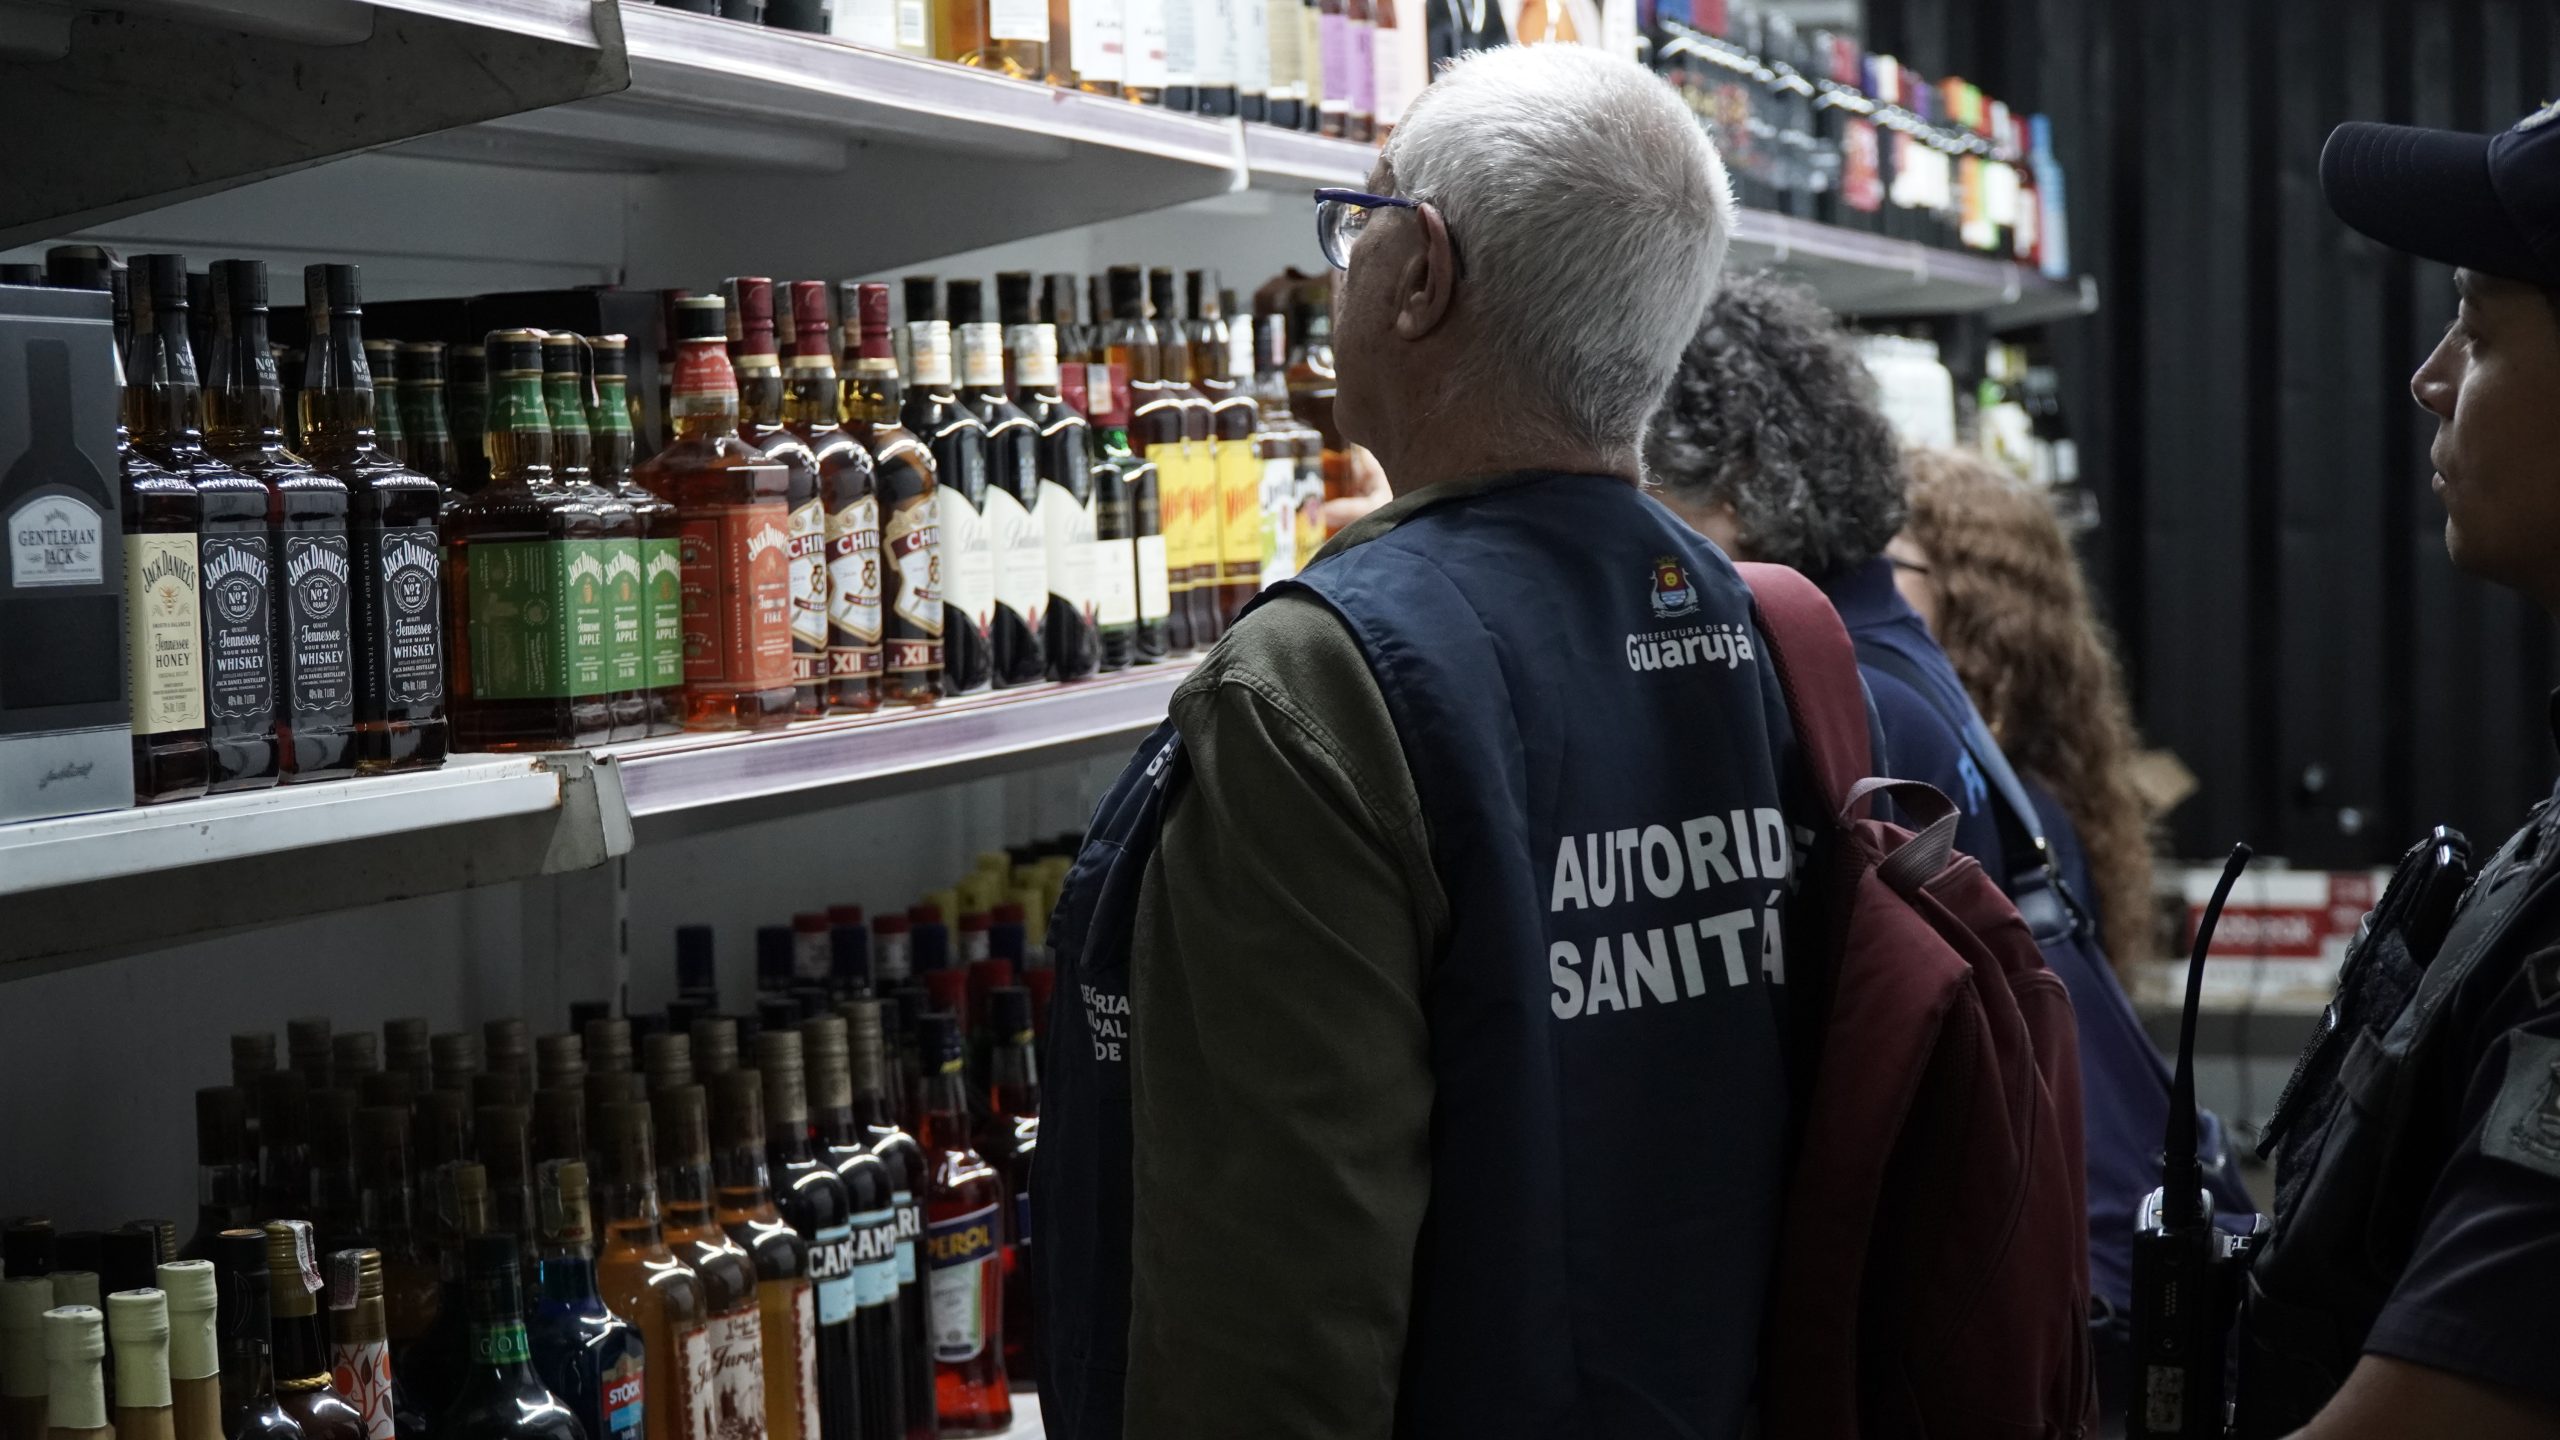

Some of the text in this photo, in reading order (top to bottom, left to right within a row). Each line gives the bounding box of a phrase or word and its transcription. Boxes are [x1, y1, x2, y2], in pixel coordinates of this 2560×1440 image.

[18, 528, 96, 547] GENTLEMAN
[44, 548, 75, 566] JACK
[287, 543, 350, 587] JACK DANIEL'S
[382, 547, 404, 582] JACK
[402, 540, 439, 580] DANIEL'S
[142, 550, 196, 594] JACK DANIEL'S
[203, 545, 268, 590] JACK DANIEL'S
[230, 604, 247, 612] BRAND
[312, 601, 328, 609] BRAND
[396, 618, 432, 637] Tennessee
[763, 611, 782, 625] FIRE
[155, 633, 190, 652] Tennessee
[219, 629, 260, 649] Tennessee
[301, 624, 341, 644] Tennessee
[578, 633, 600, 645] APPLE
[615, 629, 638, 643] APPLE
[656, 627, 677, 640] APPLE
[1637, 624, 1719, 642] PREFEITURA DE
[393, 643, 436, 659] WHISKEY
[902, 645, 928, 666] XII
[1626, 623, 1754, 671] Guarujá
[155, 652, 191, 668] HONEY
[217, 656, 264, 671] WHISKEY
[299, 650, 344, 665] WHISKEY
[833, 652, 862, 673] XII
[368, 647, 376, 699] TENNESSEE
